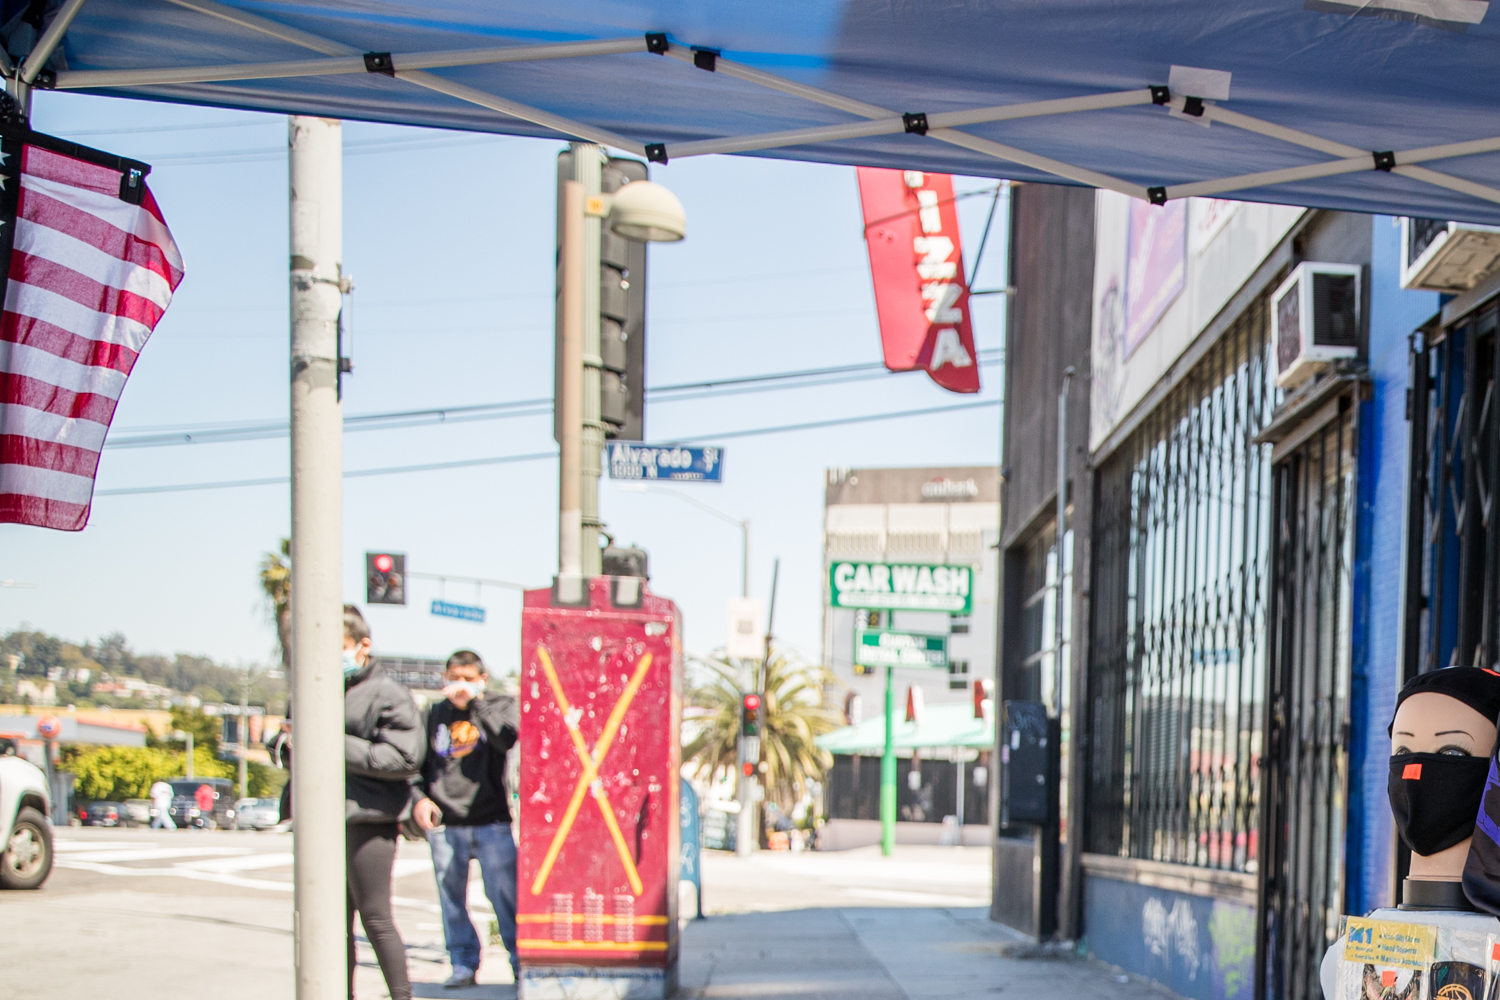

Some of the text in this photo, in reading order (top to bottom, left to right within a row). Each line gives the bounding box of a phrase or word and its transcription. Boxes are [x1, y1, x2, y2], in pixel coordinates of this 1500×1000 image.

[903, 170, 973, 371] IZZA
[612, 443, 692, 468] Alvarado
[834, 563, 970, 597] CAR WASH
